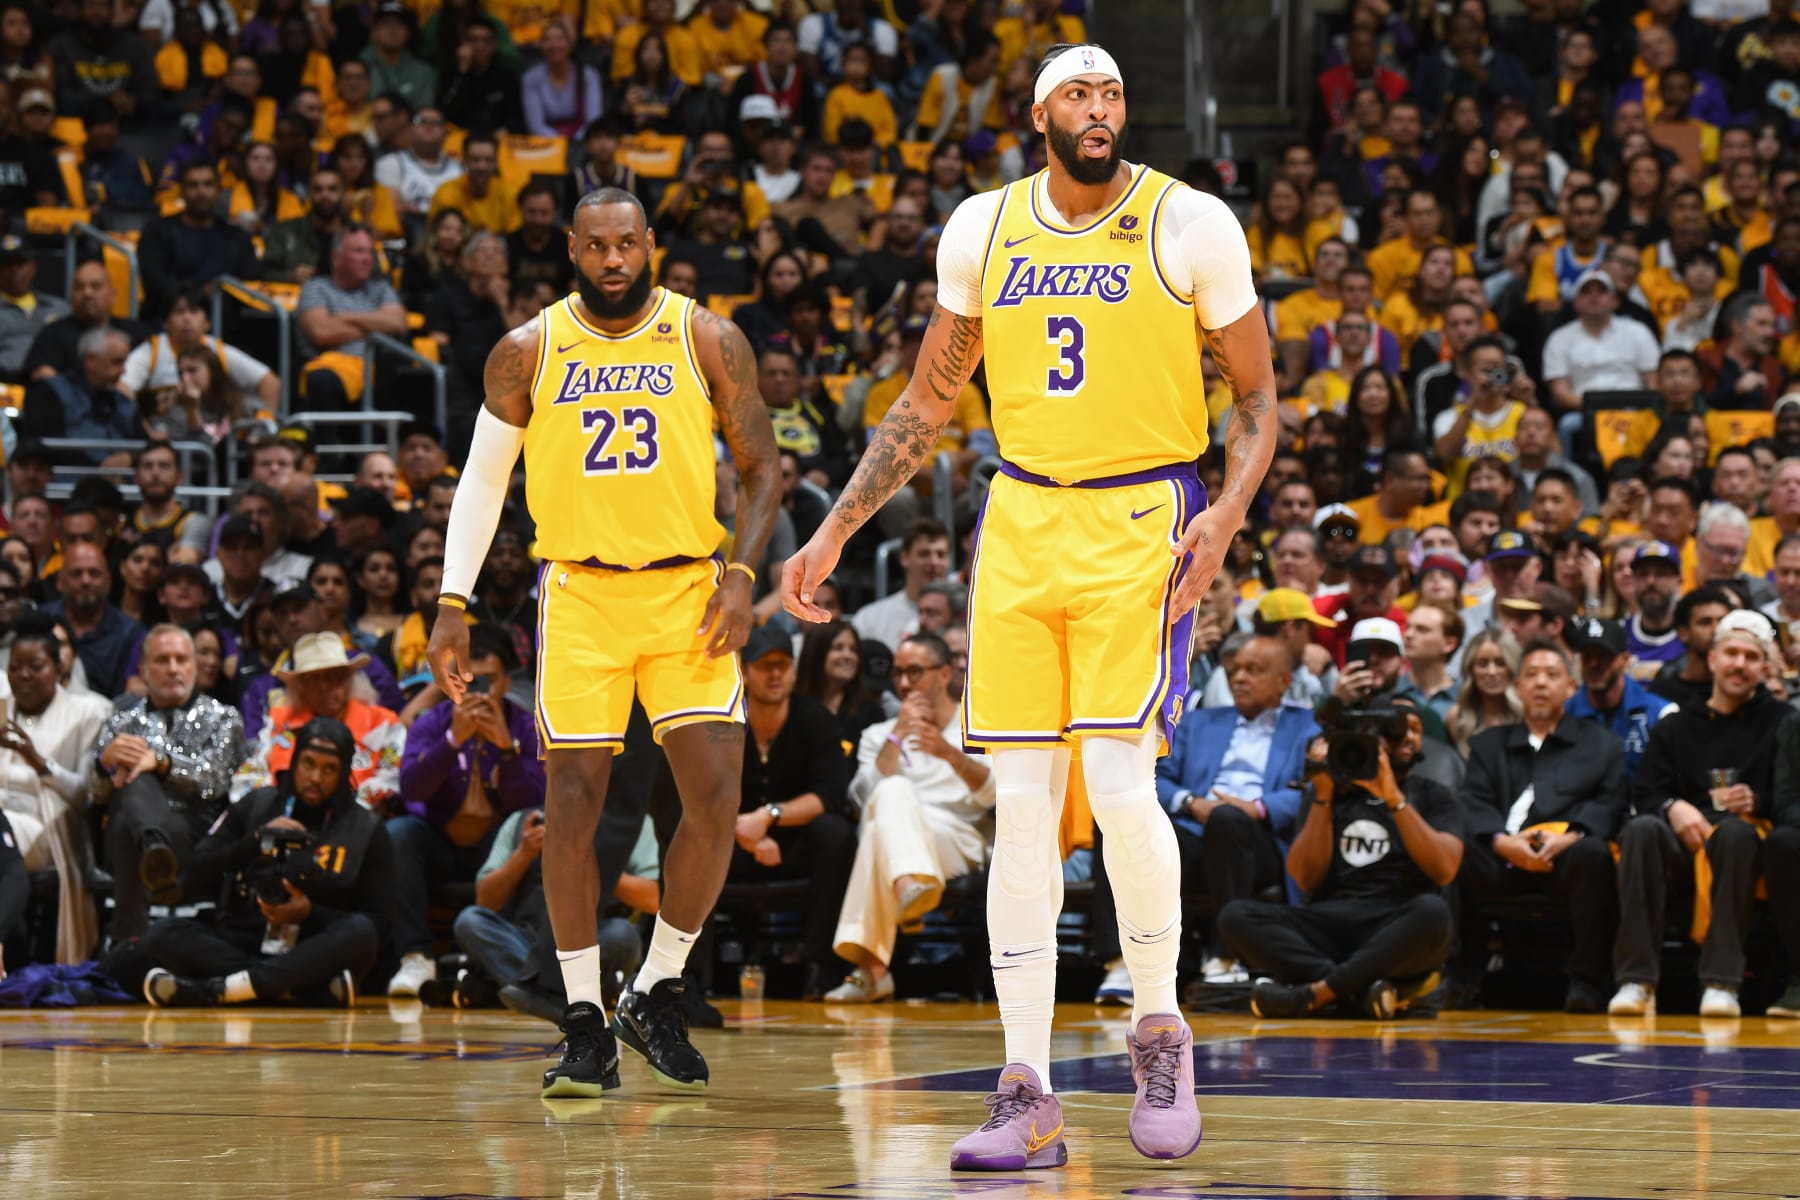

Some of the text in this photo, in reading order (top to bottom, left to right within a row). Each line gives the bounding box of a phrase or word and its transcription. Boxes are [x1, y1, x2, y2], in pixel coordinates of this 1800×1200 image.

[1109, 231, 1143, 244] bibigo
[992, 256, 1131, 308] LAKERS
[1047, 316, 1086, 397] 3
[553, 361, 675, 405] LAKERS
[582, 407, 659, 477] 23
